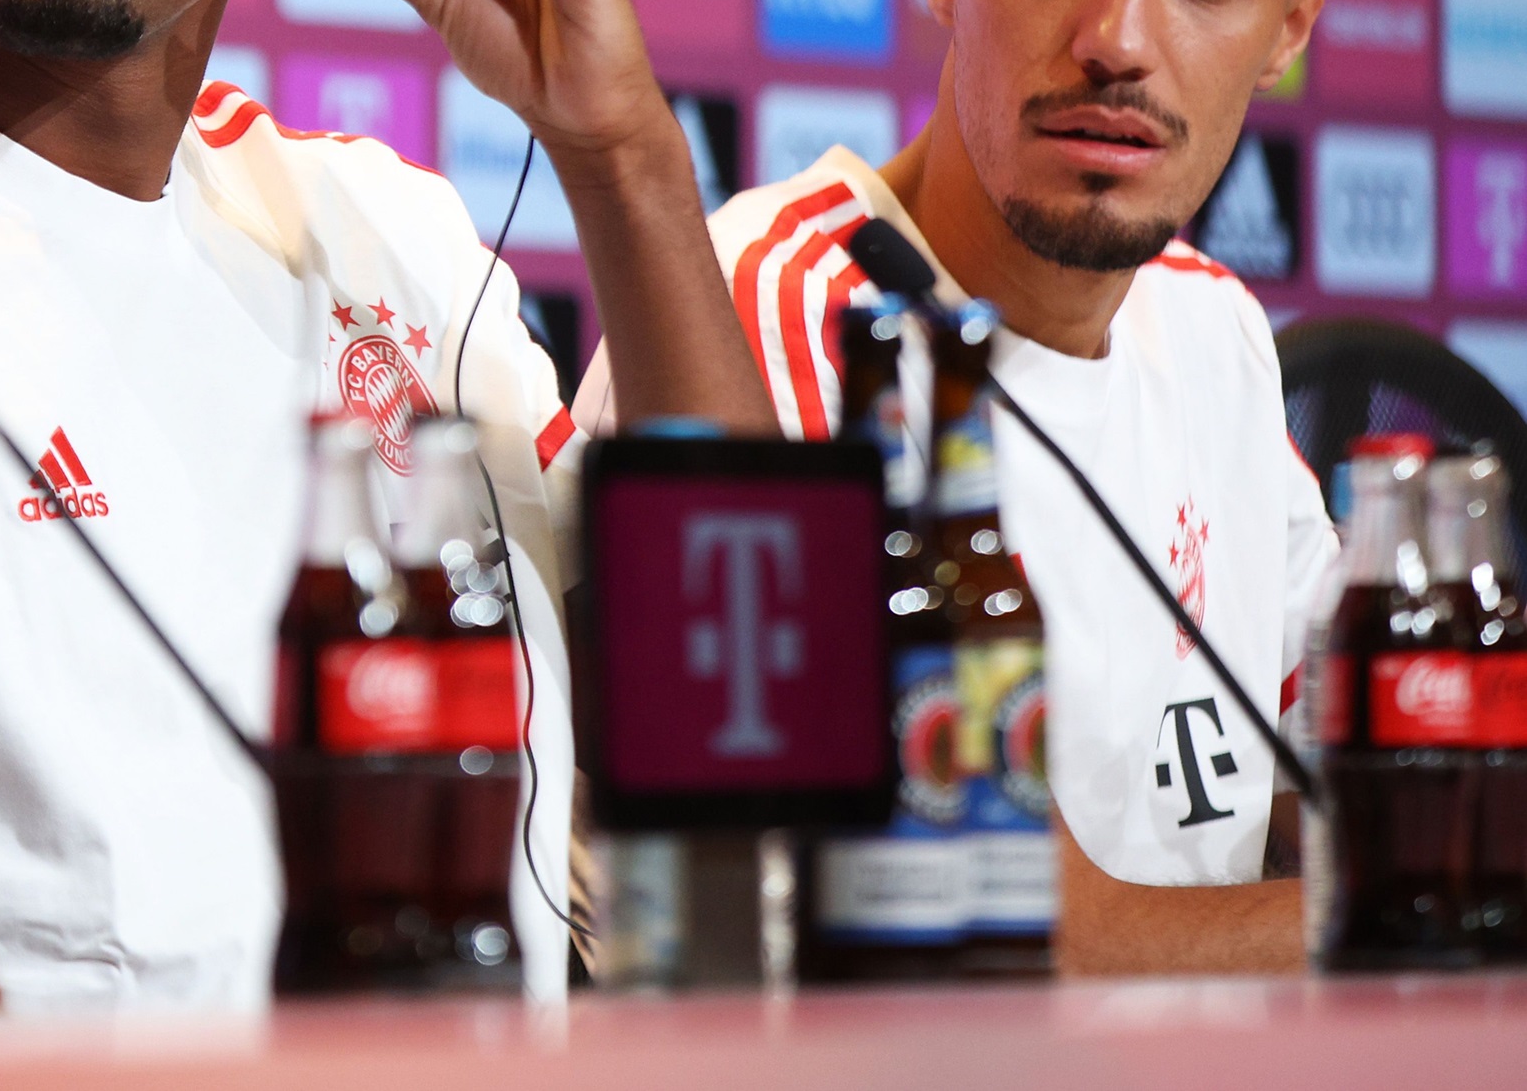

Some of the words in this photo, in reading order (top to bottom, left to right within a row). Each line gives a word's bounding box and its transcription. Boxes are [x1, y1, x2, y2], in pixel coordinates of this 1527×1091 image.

[351, 345, 414, 388] BAYERN
[347, 373, 366, 403] FC
[18, 487, 109, 522] adidas
